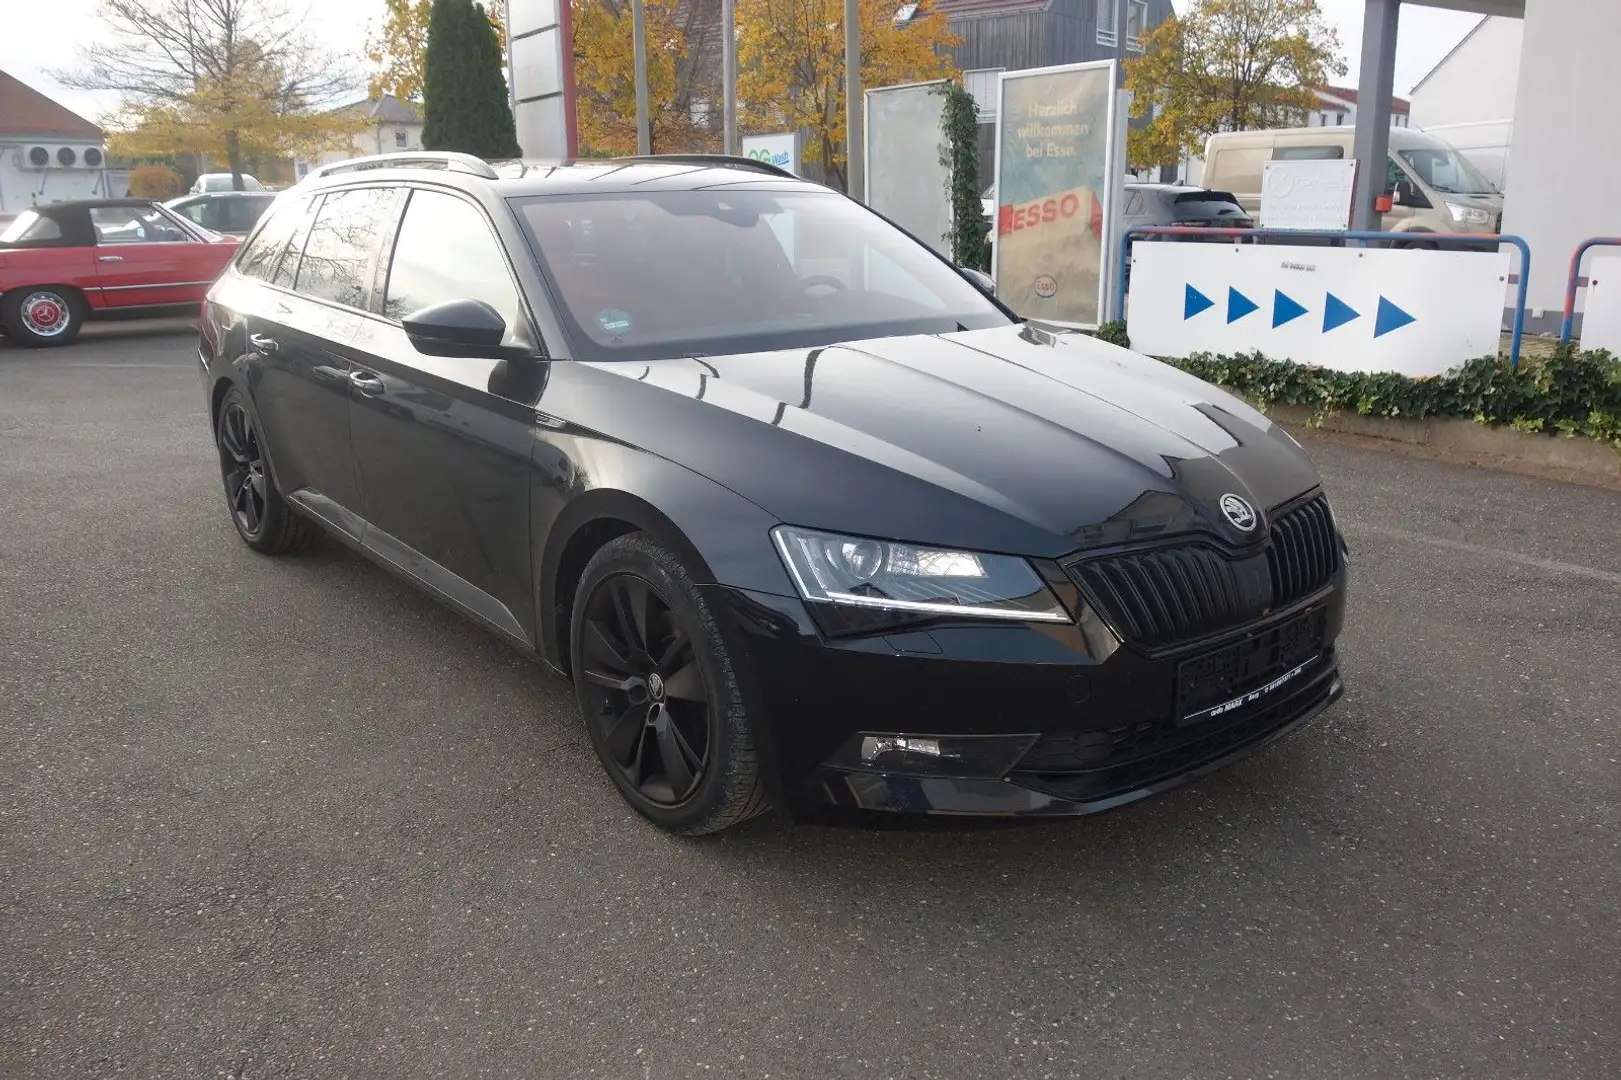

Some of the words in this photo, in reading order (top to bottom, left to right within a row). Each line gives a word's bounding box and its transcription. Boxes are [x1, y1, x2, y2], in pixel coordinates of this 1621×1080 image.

[1028, 101, 1077, 117] Herzlich
[1018, 122, 1089, 137] willkommen
[1026, 142, 1043, 159] bei
[1013, 193, 1079, 231] ESSO
